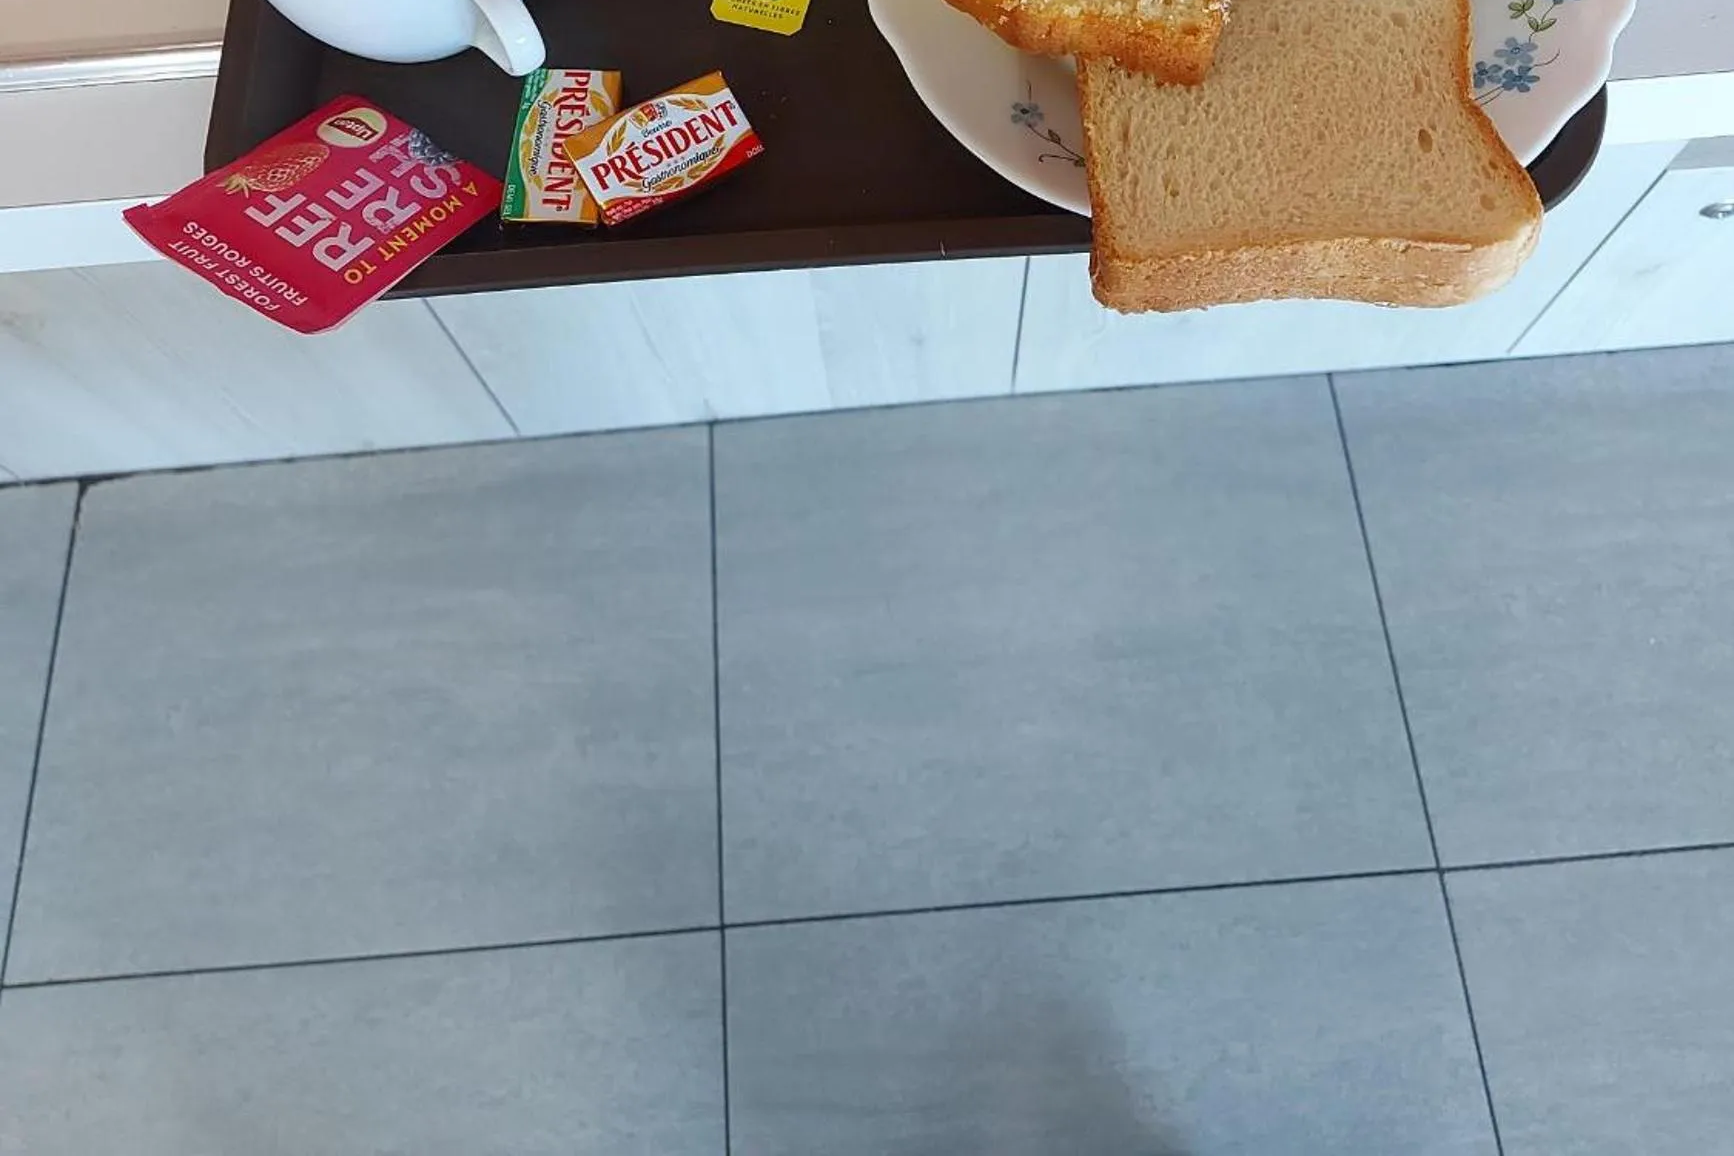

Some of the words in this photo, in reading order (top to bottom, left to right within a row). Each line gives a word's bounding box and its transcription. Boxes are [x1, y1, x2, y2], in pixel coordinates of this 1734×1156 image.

[332, 117, 375, 142] Lipton
[528, 99, 552, 175] Gastronomique
[542, 72, 592, 211] PRÉSIDENT
[590, 99, 738, 191] PRÉSIDENT
[462, 180, 479, 197] A
[640, 146, 721, 193] Gastronomique
[325, 168, 421, 234] RE
[183, 220, 252, 270] ROUGES
[244, 193, 376, 272] REF
[377, 193, 465, 262] MOMENT
[168, 239, 219, 272] FRUIT
[344, 259, 378, 285] TO
[214, 268, 281, 312] FOREST
[249, 265, 309, 307] FRUITS
